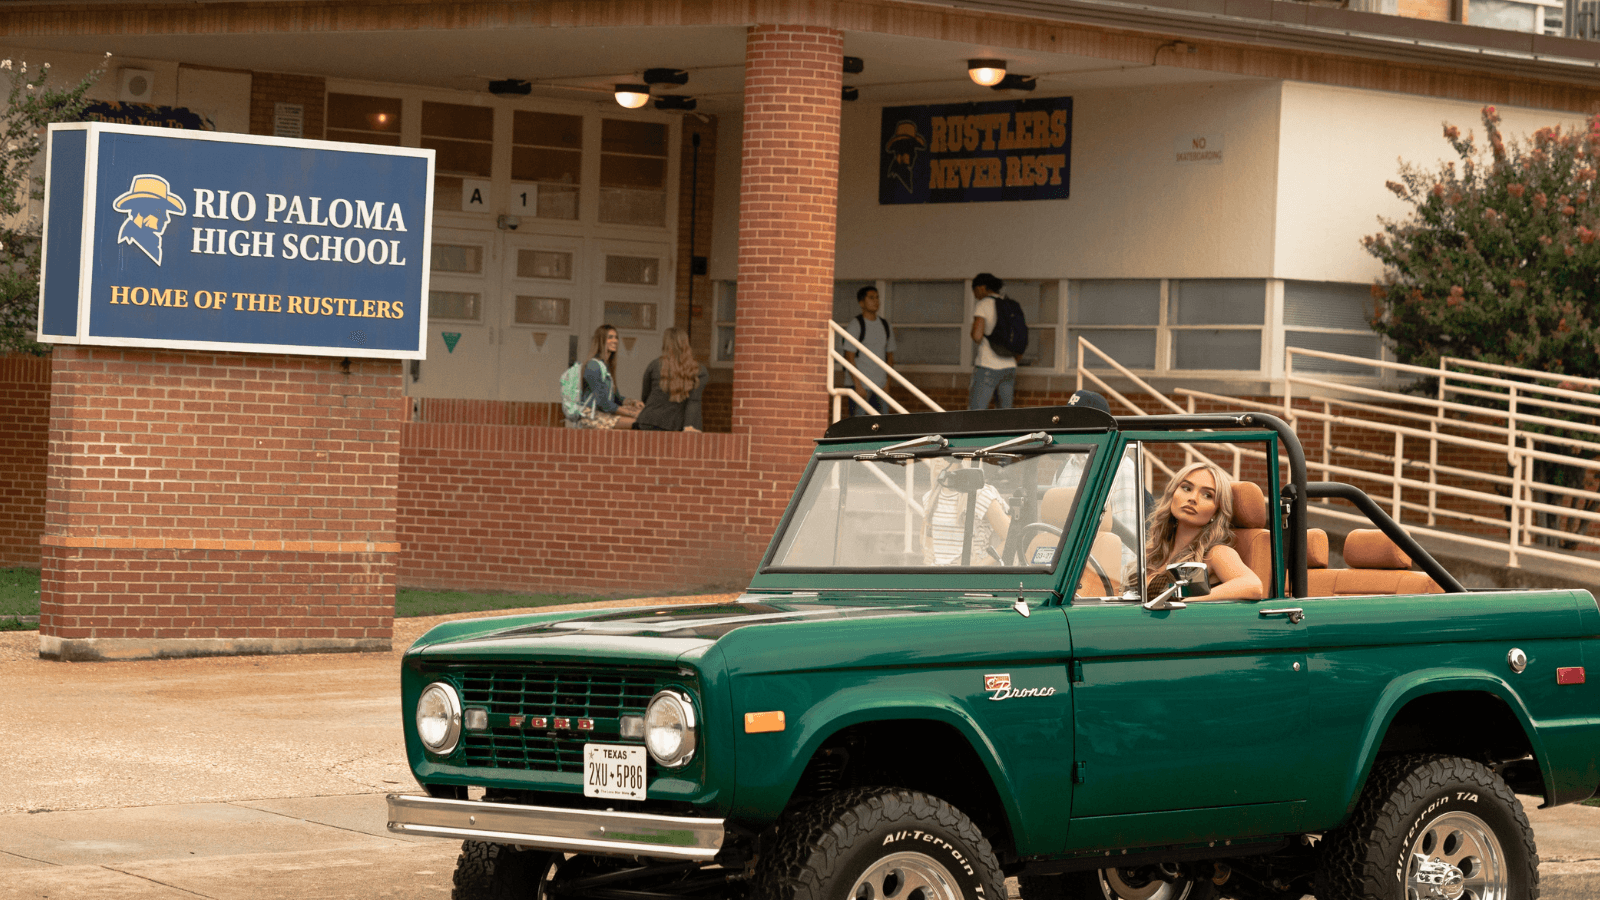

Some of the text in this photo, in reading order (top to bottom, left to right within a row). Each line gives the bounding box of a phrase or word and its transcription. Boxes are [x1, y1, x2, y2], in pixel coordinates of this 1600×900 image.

[930, 110, 1067, 153] RUSTLERS
[1192, 136, 1206, 149] NO
[929, 153, 1066, 189] NEVER REST
[193, 188, 408, 232] RIO PALOMA
[470, 188, 483, 205] A
[520, 192, 527, 207] 1
[190, 228, 406, 266] HIGH SCHOOL
[110, 285, 405, 320] HOME OF THE RUSTLERS
[988, 680, 1057, 701] Bronco
[509, 715, 595, 731] FORD
[603, 749, 628, 760] TEXAS
[589, 761, 643, 790] 2XU 5P86
[882, 830, 975, 876] All-Terrain
[1396, 791, 1479, 883] All-Terrain T/A
